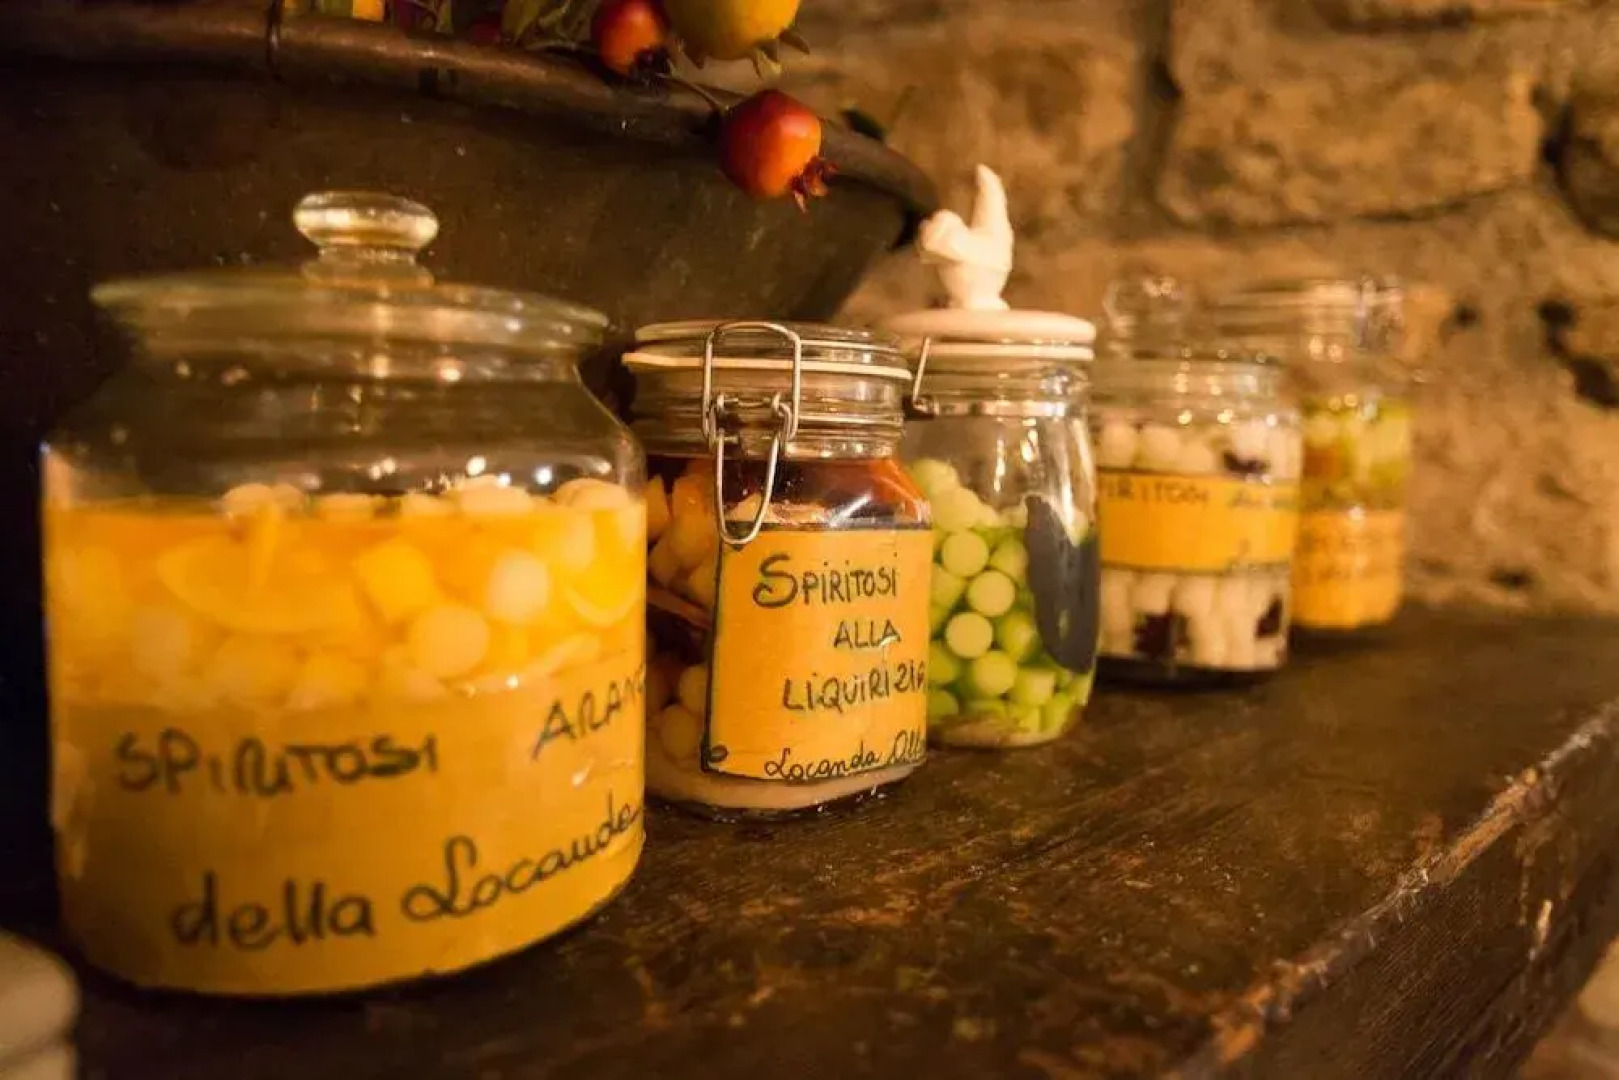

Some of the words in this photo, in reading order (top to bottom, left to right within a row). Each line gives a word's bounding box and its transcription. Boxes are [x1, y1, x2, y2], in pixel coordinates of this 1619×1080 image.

[833, 618, 902, 649] ALLA
[764, 738, 880, 780] Locanda
[170, 870, 375, 951] della
[402, 790, 644, 922] Locanda
